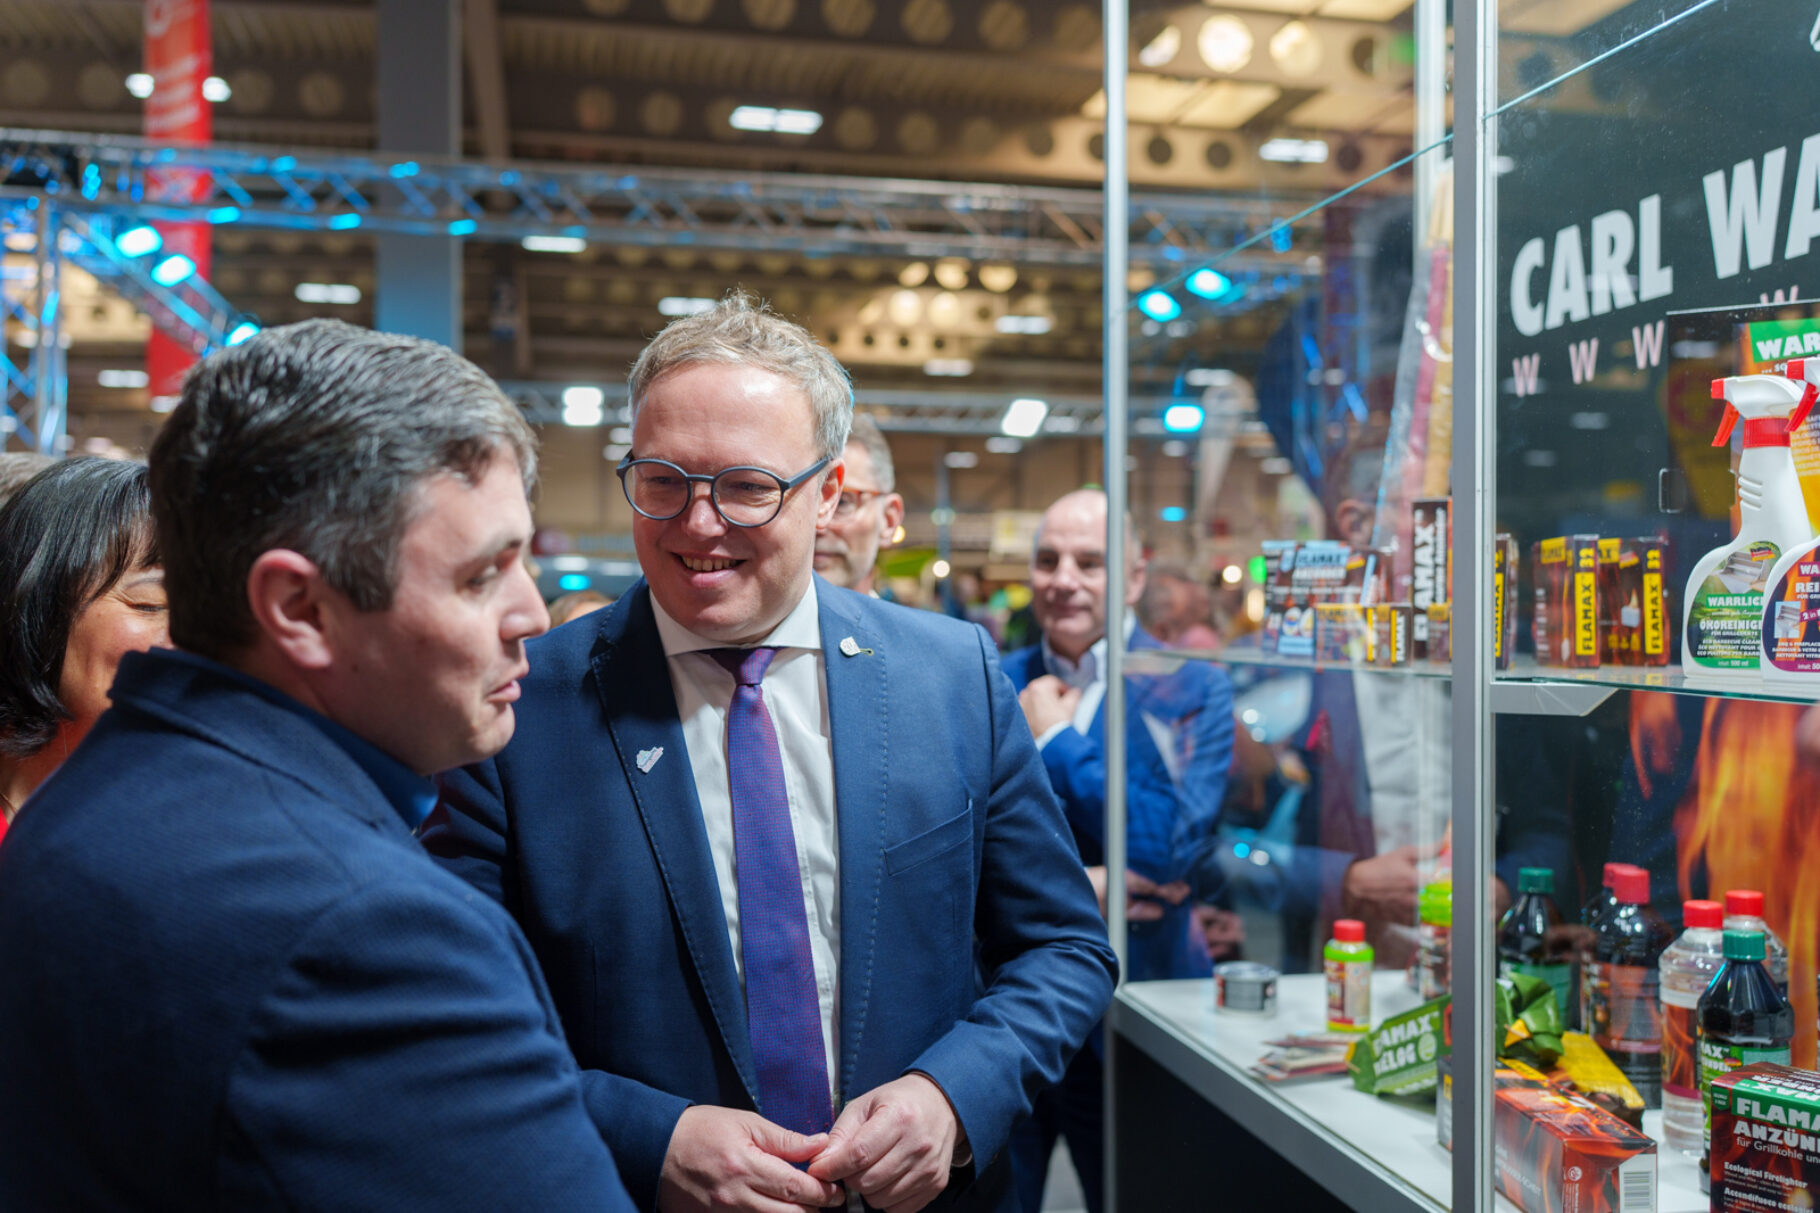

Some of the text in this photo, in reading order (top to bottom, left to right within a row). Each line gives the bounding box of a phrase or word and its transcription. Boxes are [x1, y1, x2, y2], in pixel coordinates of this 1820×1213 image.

[1510, 133, 1820, 337] CARL WA
[1756, 331, 1820, 361] WAR
[1733, 1121, 1820, 1154] ANZÜN
[1736, 1137, 1750, 1148] für
[1753, 1141, 1803, 1161] Grillkohle
[1723, 1161, 1763, 1180] Ecological
[1763, 1171, 1808, 1189] Firelighter
